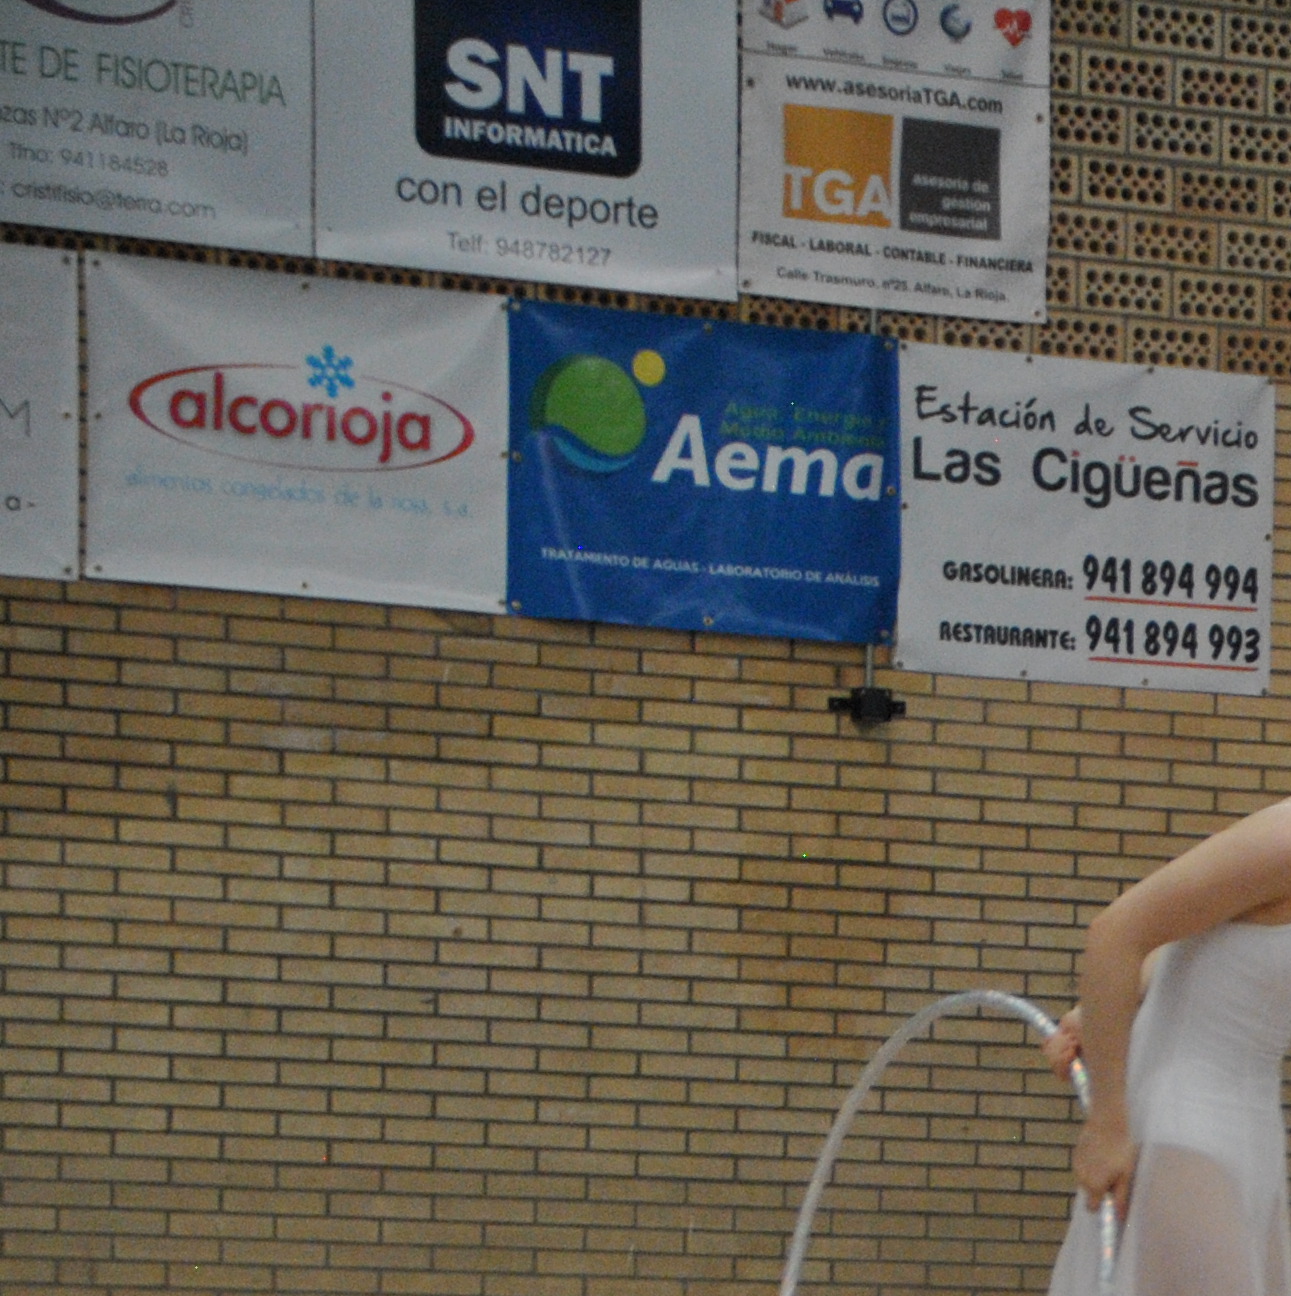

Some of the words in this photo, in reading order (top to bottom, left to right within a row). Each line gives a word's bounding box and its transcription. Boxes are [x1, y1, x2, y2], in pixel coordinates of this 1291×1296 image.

[39, 46, 79, 82] DE
[97, 53, 287, 106] FISIOTERAPIA
[444, 38, 615, 123] SNT
[786, 75, 1003, 114] www.asesoriaTGA.com
[88, 112, 149, 139] Alfaro
[156, 120, 185, 146] (La
[191, 124, 249, 155] Rioja)
[444, 116, 617, 157] INFORMATICA
[396, 177, 462, 206] con
[477, 180, 507, 211] el
[521, 185, 658, 228] deporte
[784, 166, 892, 217] TGA
[495, 237, 612, 267] 948782127
[752, 230, 796, 249] FISCAL
[808, 238, 872, 257] LABORAL
[883, 246, 946, 266] CONTABLE
[956, 254, 1034, 273] FINANCIERA
[777, 266, 808, 282] Calle
[957, 288, 971, 298] La
[169, 371, 432, 463] alcorioja
[915, 384, 1056, 433] Estación
[1074, 403, 1115, 437] de
[1128, 406, 1259, 450] Servicio
[651, 414, 884, 501] Aema
[912, 436, 1002, 487] Las
[1032, 447, 1260, 509] Cigüeñas
[541, 547, 629, 567] TRATAMIENTO
[633, 555, 649, 569] DE
[653, 558, 699, 574] AGUAS
[709, 563, 801, 581] LABORATORIO
[805, 570, 822, 582] DE
[943, 560, 1074, 590] GASOLINERA:
[1082, 554, 1133, 594] 941
[1141, 560, 1195, 599] 894
[1205, 564, 1260, 603] 994
[938, 620, 1077, 652] RESTAURANTE:
[1085, 614, 1135, 655] 941
[1143, 620, 1199, 659] 894
[1208, 624, 1261, 664] 993
